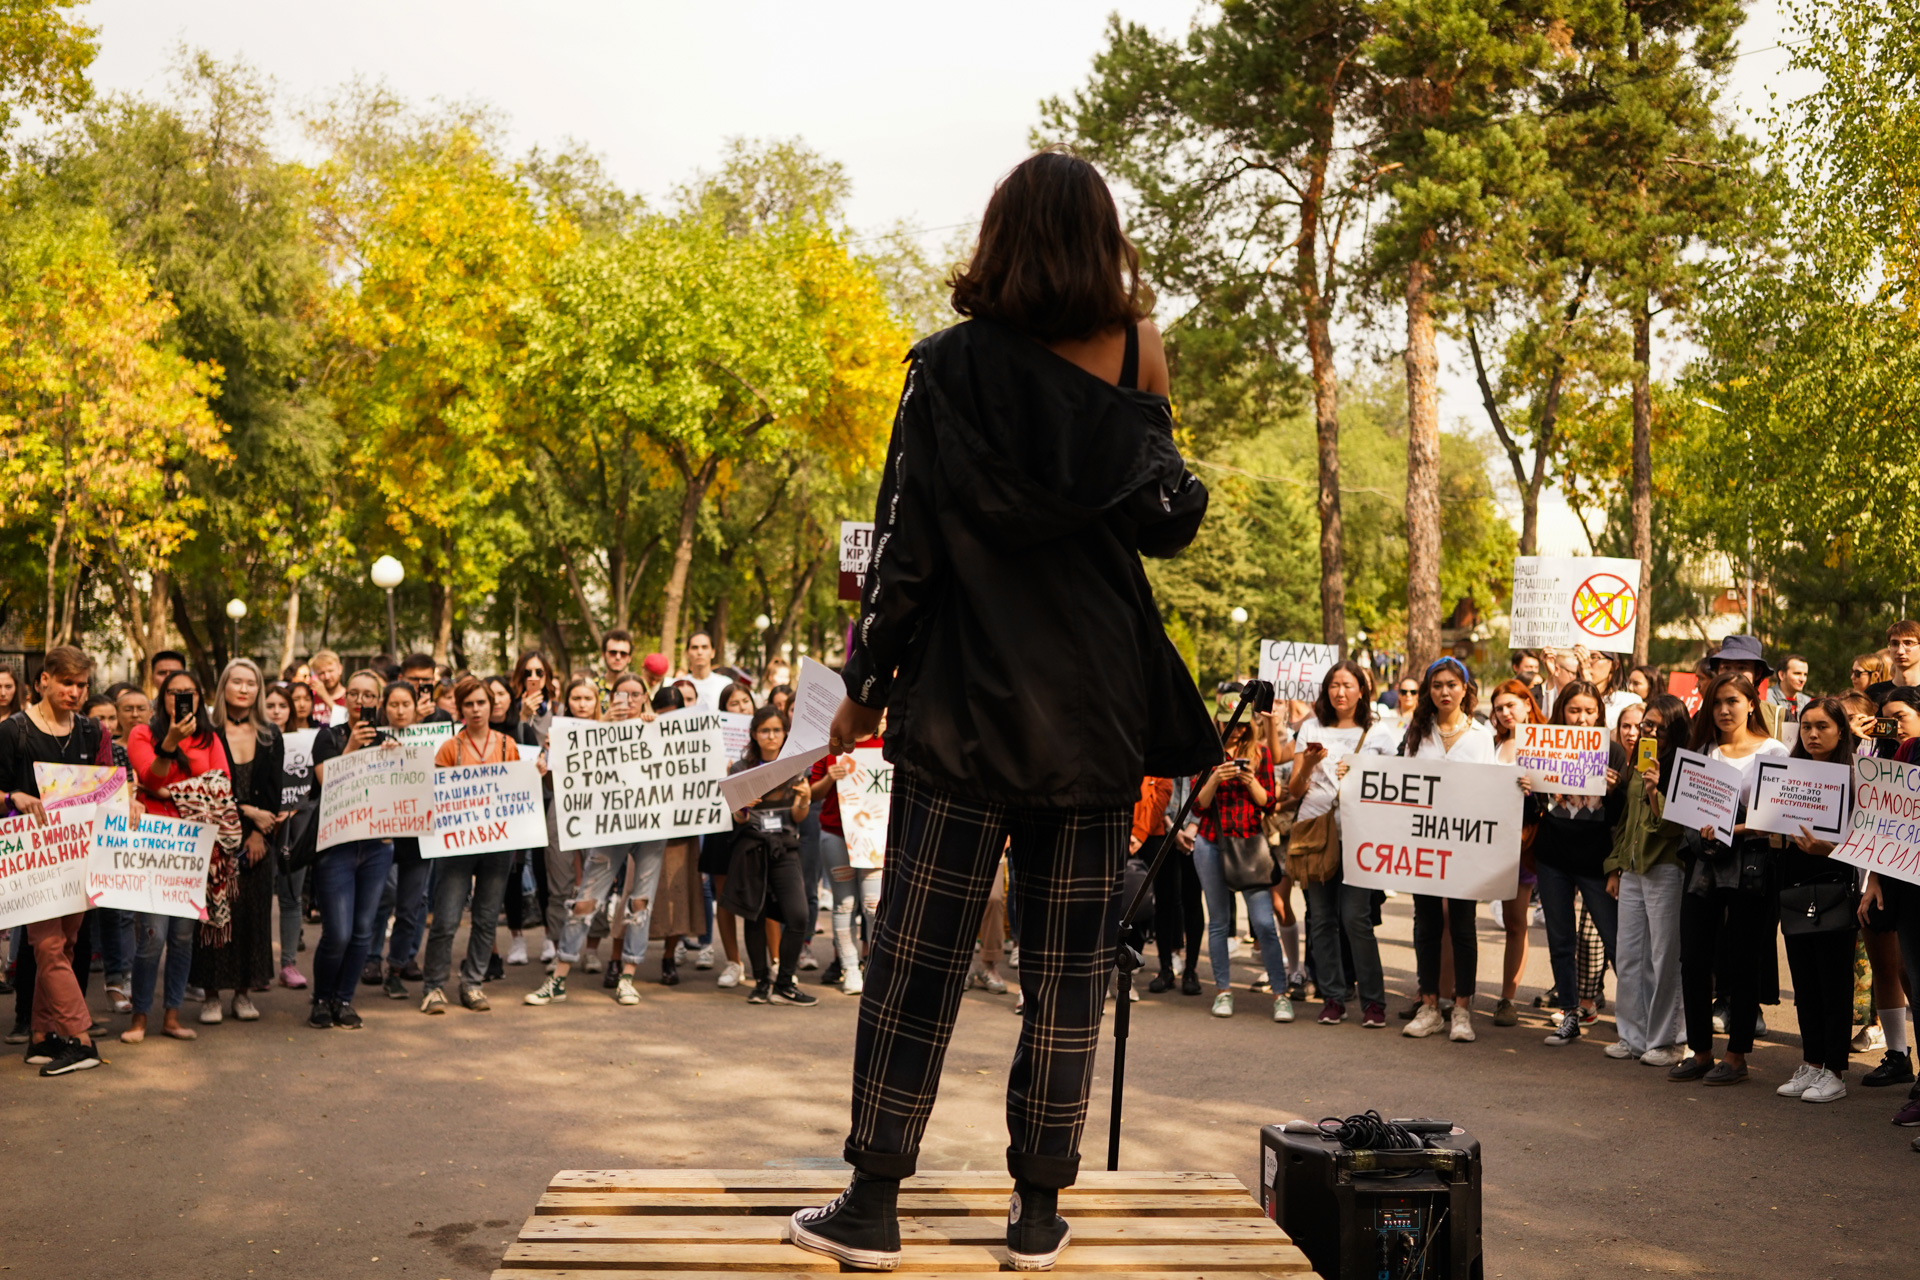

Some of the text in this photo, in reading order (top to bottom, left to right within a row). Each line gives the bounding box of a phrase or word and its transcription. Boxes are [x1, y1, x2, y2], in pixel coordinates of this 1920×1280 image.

[873, 532, 892, 570] TOMMY
[1513, 607, 1559, 618] ЛИЧНОСТЬ
[1513, 621, 1521, 633] И
[1269, 641, 1333, 666] САМА
[1276, 660, 1314, 682] НЕ
[567, 714, 721, 751] Я ПРОШУ НАШИХ
[1525, 726, 1602, 751] Я ДЕЛАЮ
[405, 748, 418, 760] НЕ
[566, 742, 653, 773] БРАТЬЕВ
[663, 739, 712, 757] ЛИШЬ
[1516, 748, 1530, 757] ЭТО
[1531, 750, 1546, 758] ДЛЯ
[1564, 752, 1579, 760] ДЛЯ
[1578, 750, 1609, 766] МАМЫ
[390, 771, 427, 786] ПРАВО
[450, 765, 508, 783] ДОЛЖНА
[563, 758, 707, 790] О ТОМ, ЧТОБЫ
[1543, 774, 1559, 784] ДЛЯ
[1560, 760, 1604, 777] ПОДРУГИ
[1682, 769, 1716, 783] #МОЛЧАНИЕ
[1858, 757, 1905, 789] ОНА
[1360, 770, 1442, 806] БЬЕТ
[1689, 782, 1731, 802] БЕЗНАКАЗАННОСТЬ
[1762, 775, 1841, 792] БЬЕТ ЭТО НЕ 12 МРП!
[1781, 785, 1821, 796] БЬЕТ ЭТО
[497, 791, 531, 804] ЧТОБЫ
[563, 792, 593, 813] ОНИ
[602, 784, 675, 811] УБРАЛИ
[1680, 791, 1700, 801] НОВОЕ
[1770, 797, 1829, 812] ПРЕСТУПЛЕНИЕ!
[1779, 791, 1822, 804] УГОЛОВНОЕ
[104, 813, 127, 832] МЫ
[177, 823, 204, 838] КАК
[318, 798, 419, 844] НЕТ МАТКИ НЕТ
[369, 809, 433, 836] МНЕНИЯ!
[434, 801, 536, 830] ВОРИТЬ О СВОИХ
[566, 801, 722, 838] С НАШИХ ШЕЙ
[1854, 810, 1876, 831] ОН
[1876, 817, 1898, 836] НЕ
[31, 820, 94, 850] ВИНОВАТ
[97, 834, 196, 853] К НАМ ОТНОСИТСЯ
[443, 821, 509, 849] ПРАВАХ
[113, 851, 205, 871] ГОСУДАРСТВО
[1356, 842, 1453, 880] СЯДЕТ
[1837, 829, 1920, 877] НАСИЛ
[9, 878, 23, 892] ОН
[27, 866, 61, 888] РЕШАЕТ
[61, 879, 82, 898] ИЛИ
[90, 871, 203, 892] ИНКУБАТОР ПУШЕЧНОЕ
[162, 890, 191, 904] МЯСО
